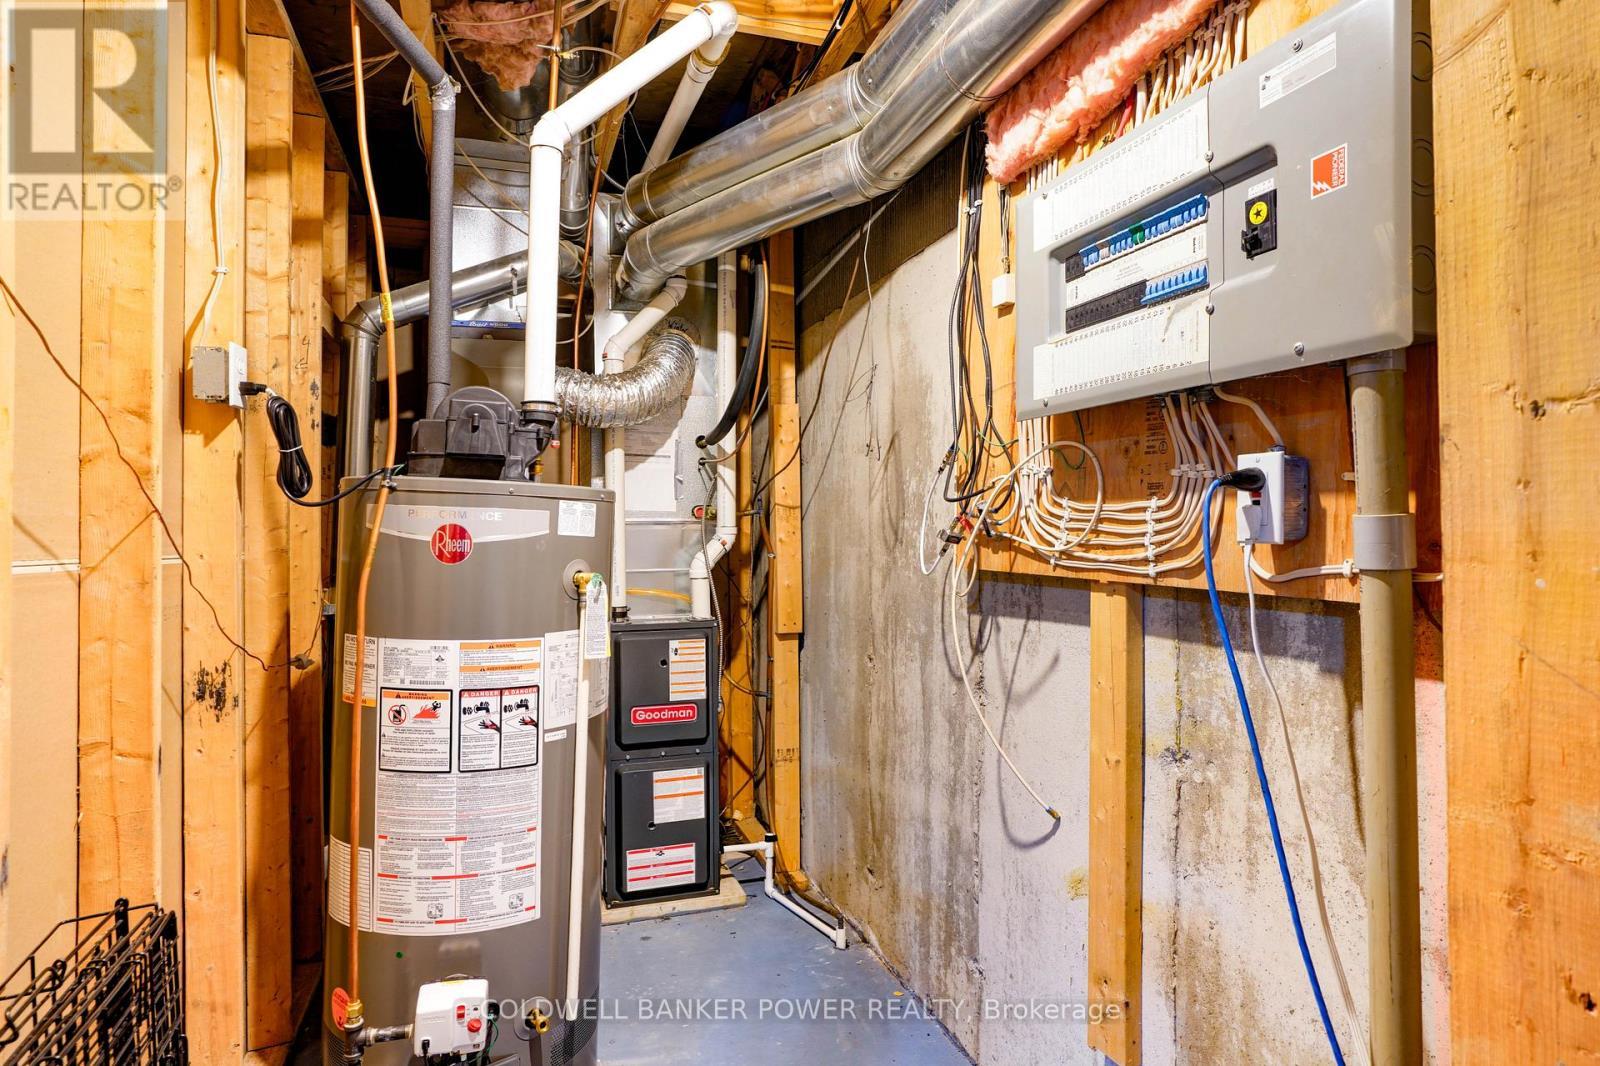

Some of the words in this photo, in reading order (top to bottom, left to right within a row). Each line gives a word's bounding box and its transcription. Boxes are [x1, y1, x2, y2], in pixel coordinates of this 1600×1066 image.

[407, 508, 504, 522] PERFORMNCE
[435, 530, 471, 558] Rheem
[636, 707, 694, 722] Goodman
